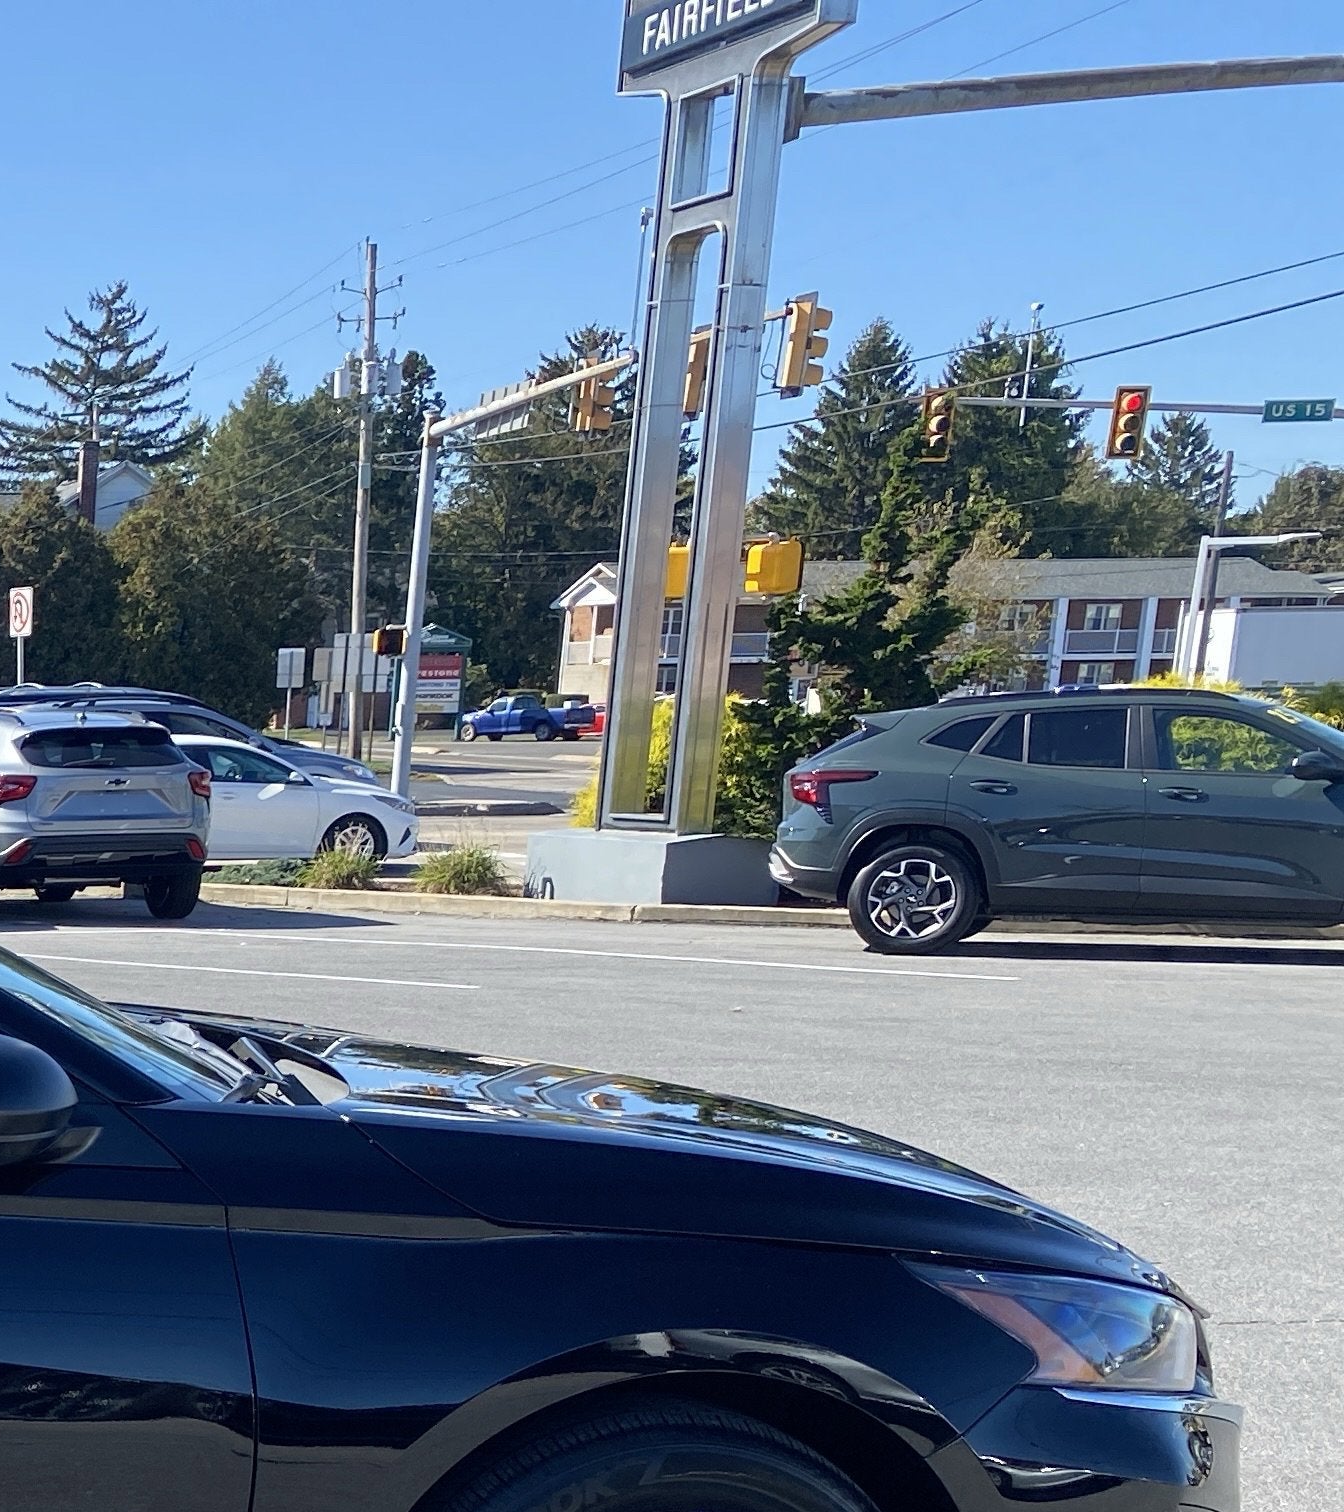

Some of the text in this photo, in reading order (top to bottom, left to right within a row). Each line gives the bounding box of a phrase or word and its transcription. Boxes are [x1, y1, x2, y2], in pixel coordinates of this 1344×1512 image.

[641, 0, 774, 56] FAIRFIE
[1272, 403, 1326, 417] US 15
